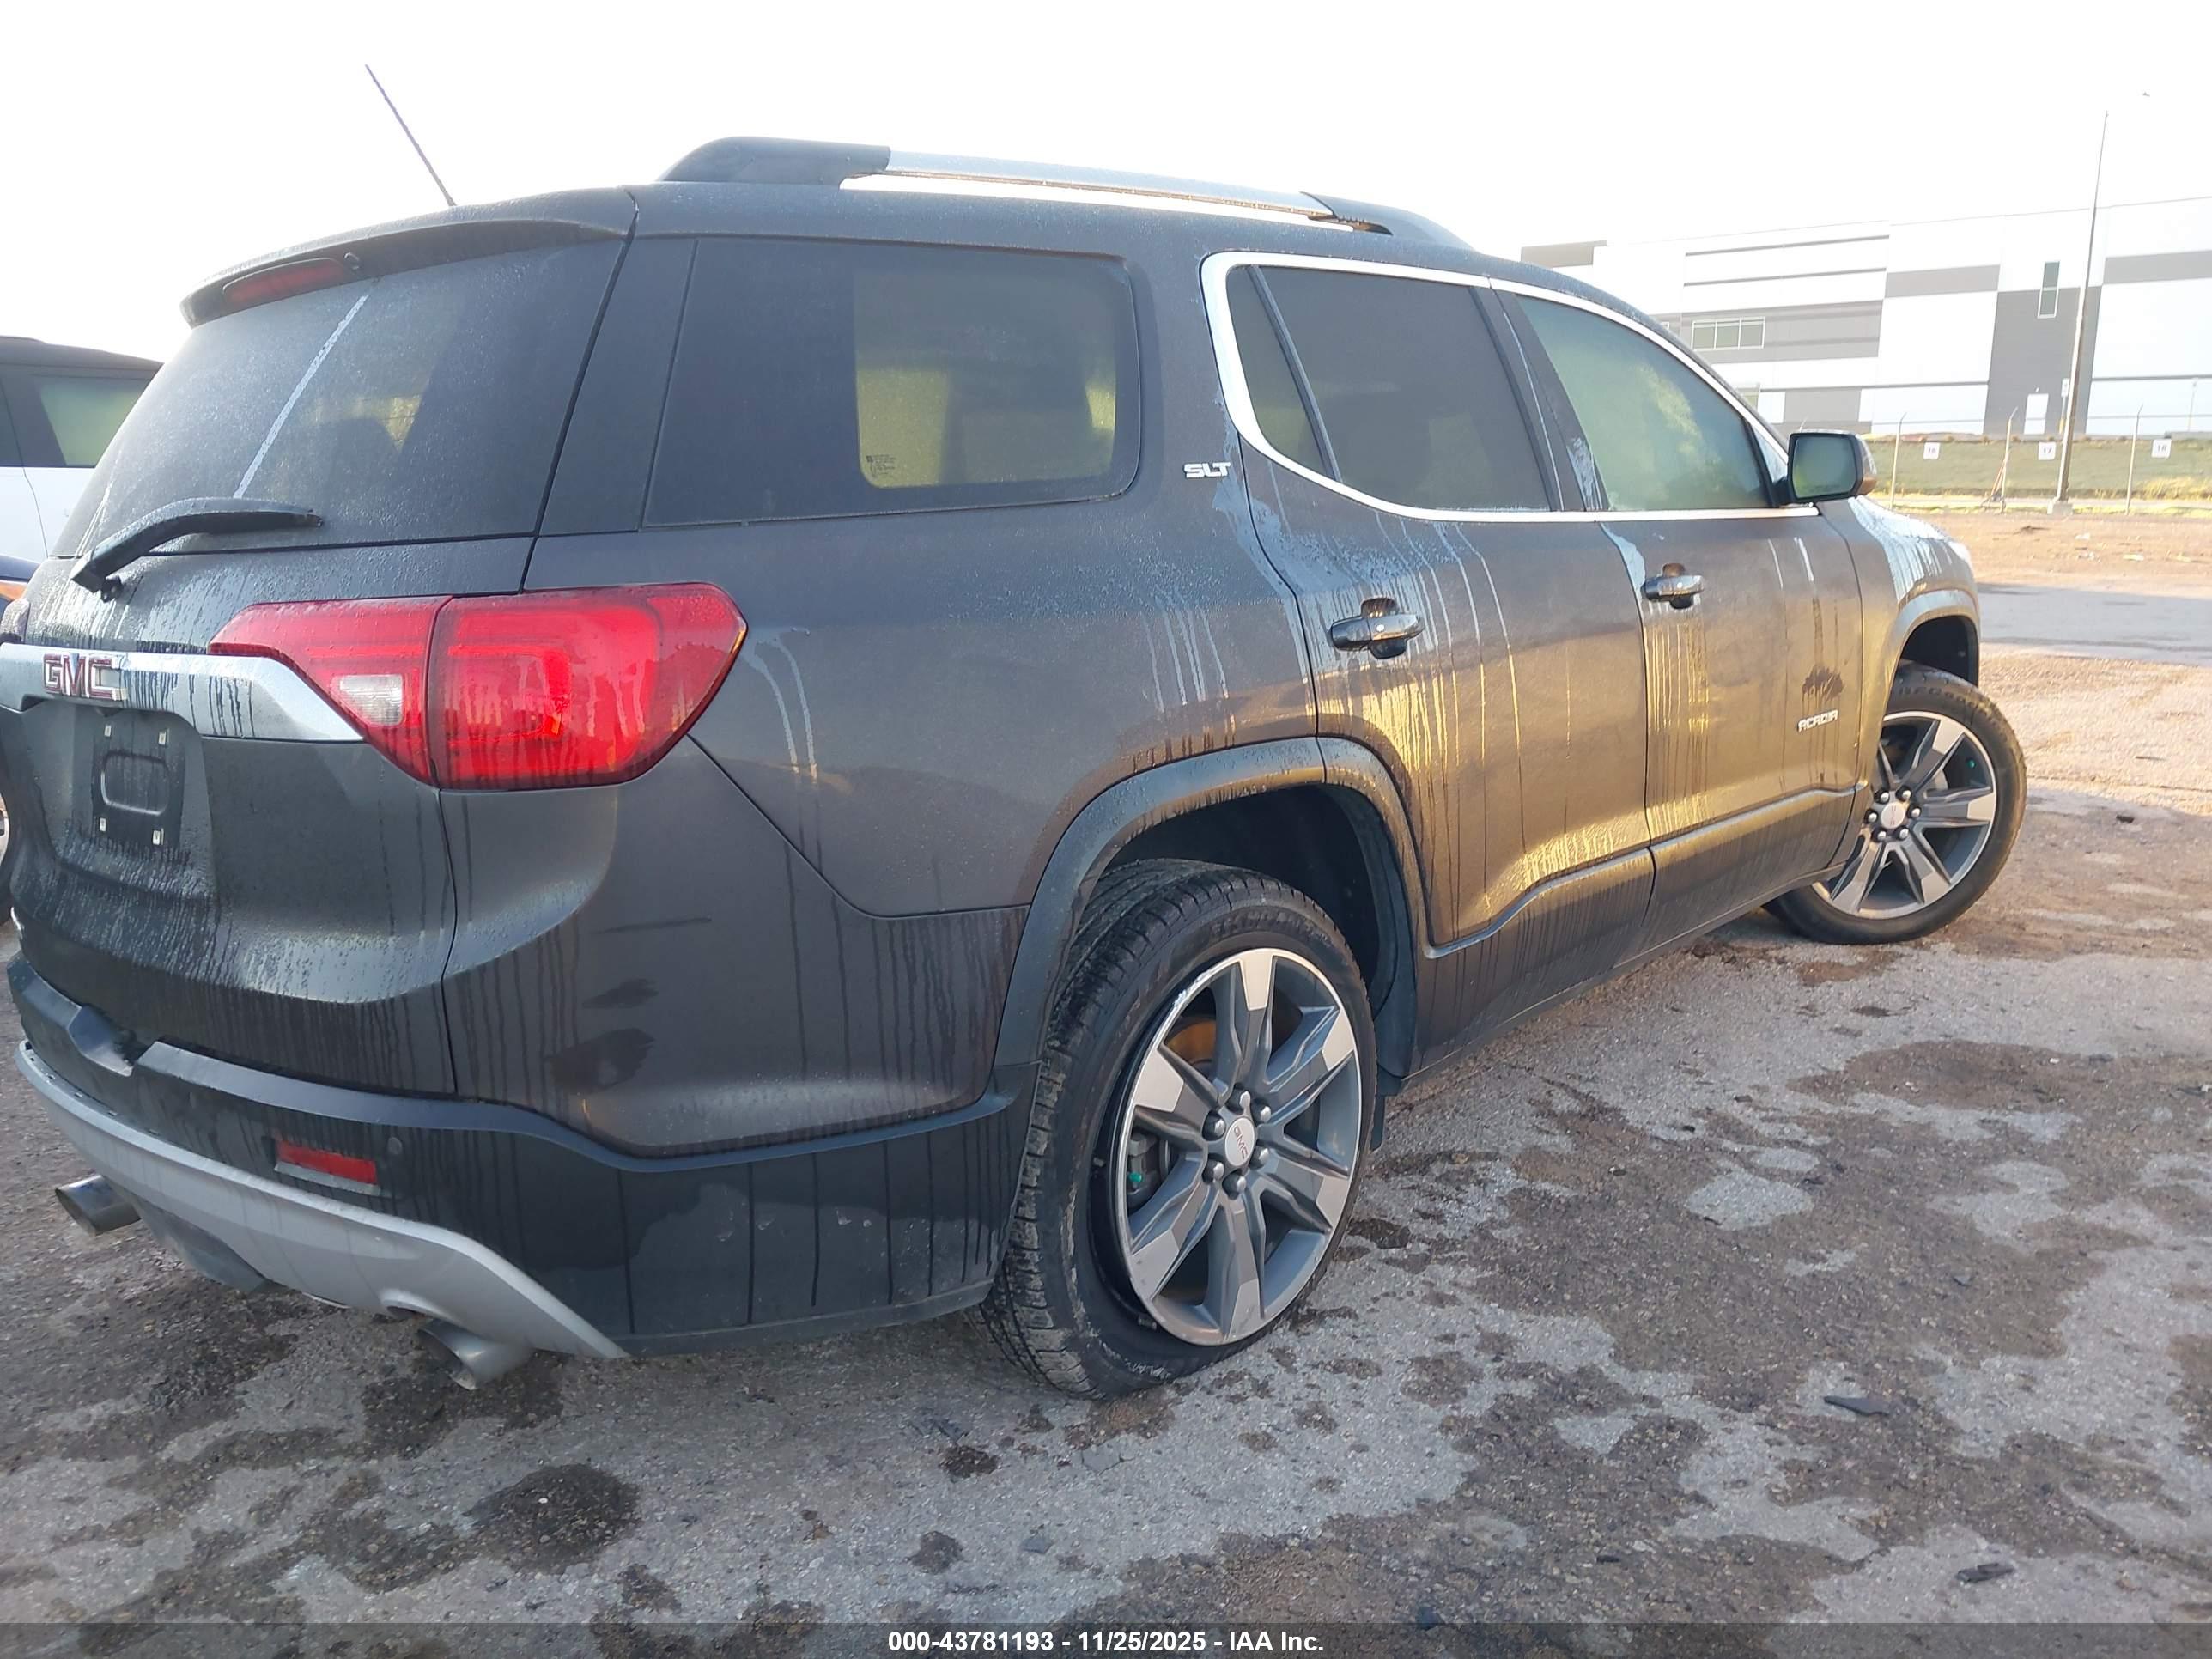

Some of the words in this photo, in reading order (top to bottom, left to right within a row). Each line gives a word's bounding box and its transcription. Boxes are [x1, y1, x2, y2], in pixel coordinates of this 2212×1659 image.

[1183, 462, 1231, 478] SLT
[44, 653, 126, 701] GMC
[1797, 709, 1838, 732] ACADIA
[1233, 1124, 1249, 1160] GMC
